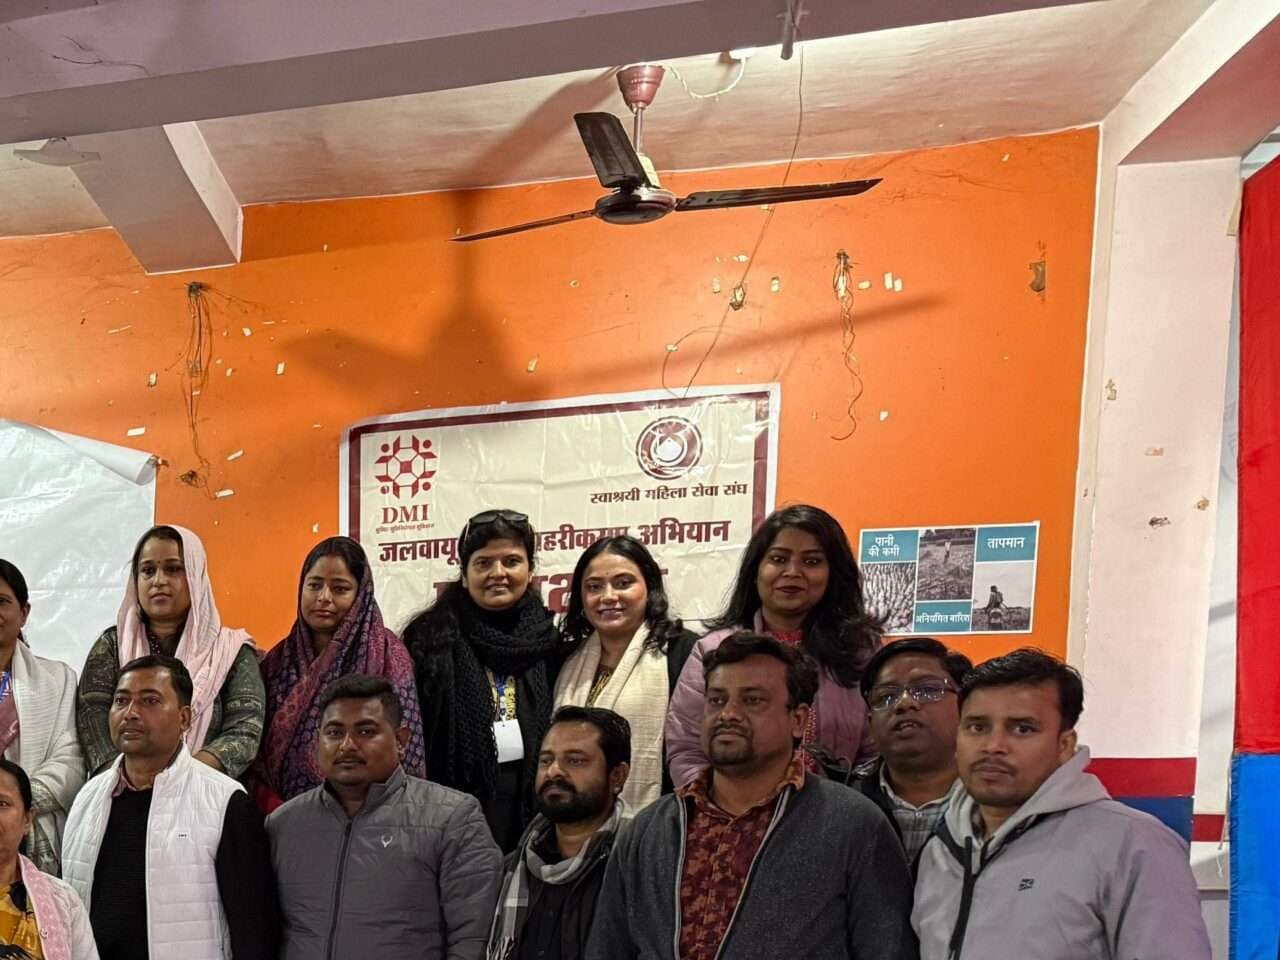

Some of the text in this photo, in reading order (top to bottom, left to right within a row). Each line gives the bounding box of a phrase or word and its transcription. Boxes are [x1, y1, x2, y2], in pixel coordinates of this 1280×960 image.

[590, 488, 641, 504] स्वाश्रयी
[692, 483, 719, 497] सेवा
[723, 481, 748, 496] संघ
[381, 503, 430, 525] DMI
[637, 517, 732, 545] अभियान
[874, 533, 894, 547] पानी
[868, 544, 900, 558] की कमी
[986, 536, 1026, 549] तापमान
